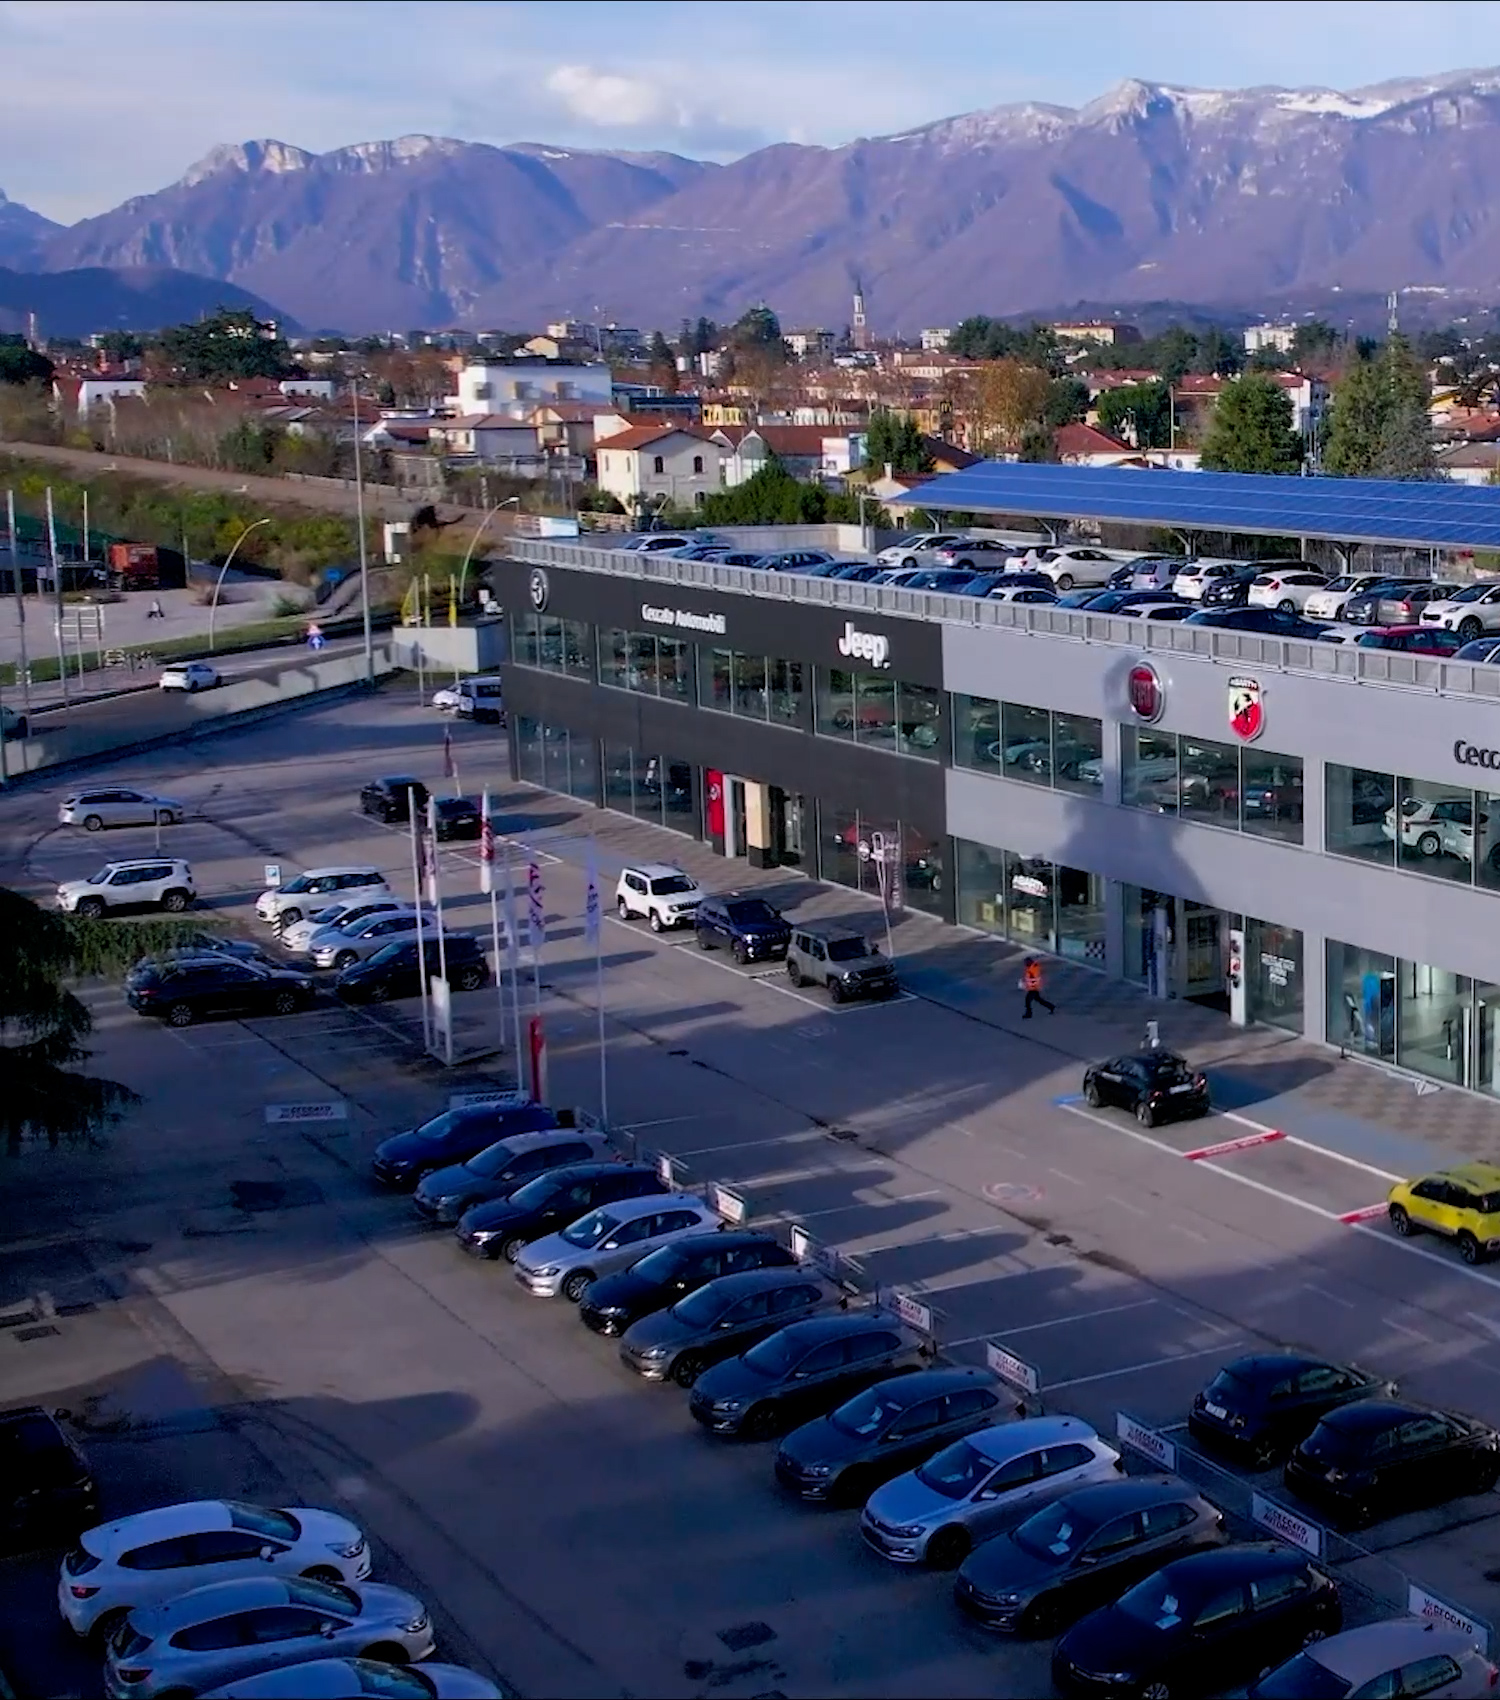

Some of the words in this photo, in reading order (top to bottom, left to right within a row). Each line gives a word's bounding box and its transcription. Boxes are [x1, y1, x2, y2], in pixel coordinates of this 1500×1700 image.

[642, 603, 675, 625] Ceccato
[675, 610, 726, 635] Automobili
[839, 621, 889, 669] Jeep
[1434, 1605, 1472, 1634] CECCATO
